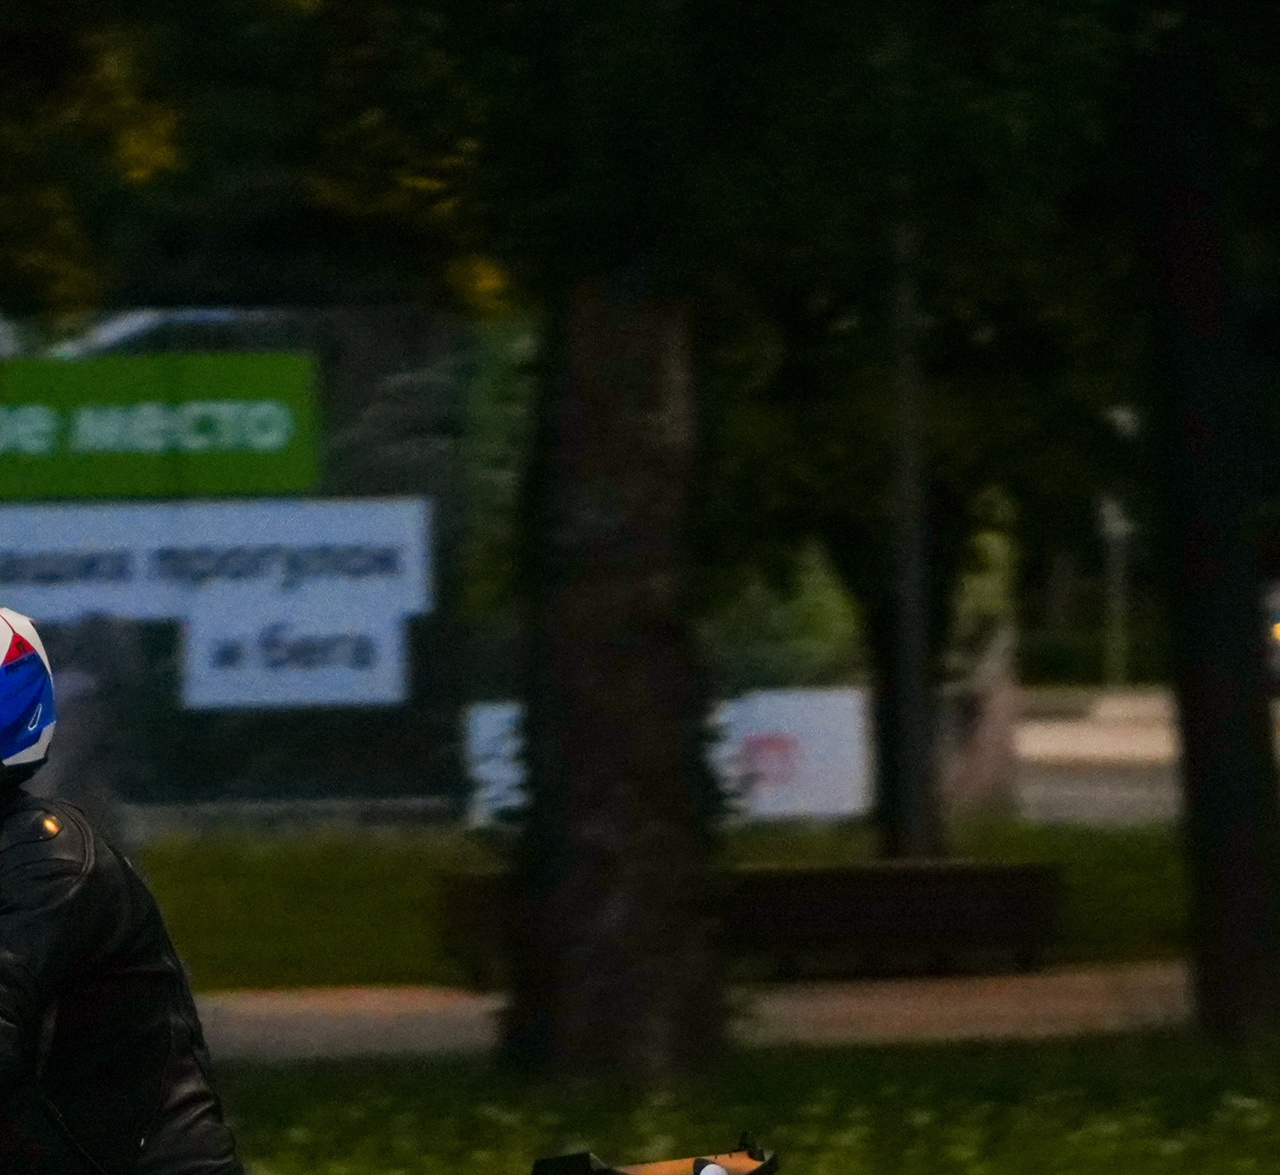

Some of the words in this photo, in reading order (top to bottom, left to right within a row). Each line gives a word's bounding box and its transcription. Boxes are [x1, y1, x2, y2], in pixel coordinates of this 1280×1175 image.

[72, 399, 295, 454] место
[150, 543, 400, 592] прогулок
[210, 637, 243, 669] и
[261, 621, 375, 671] бега
